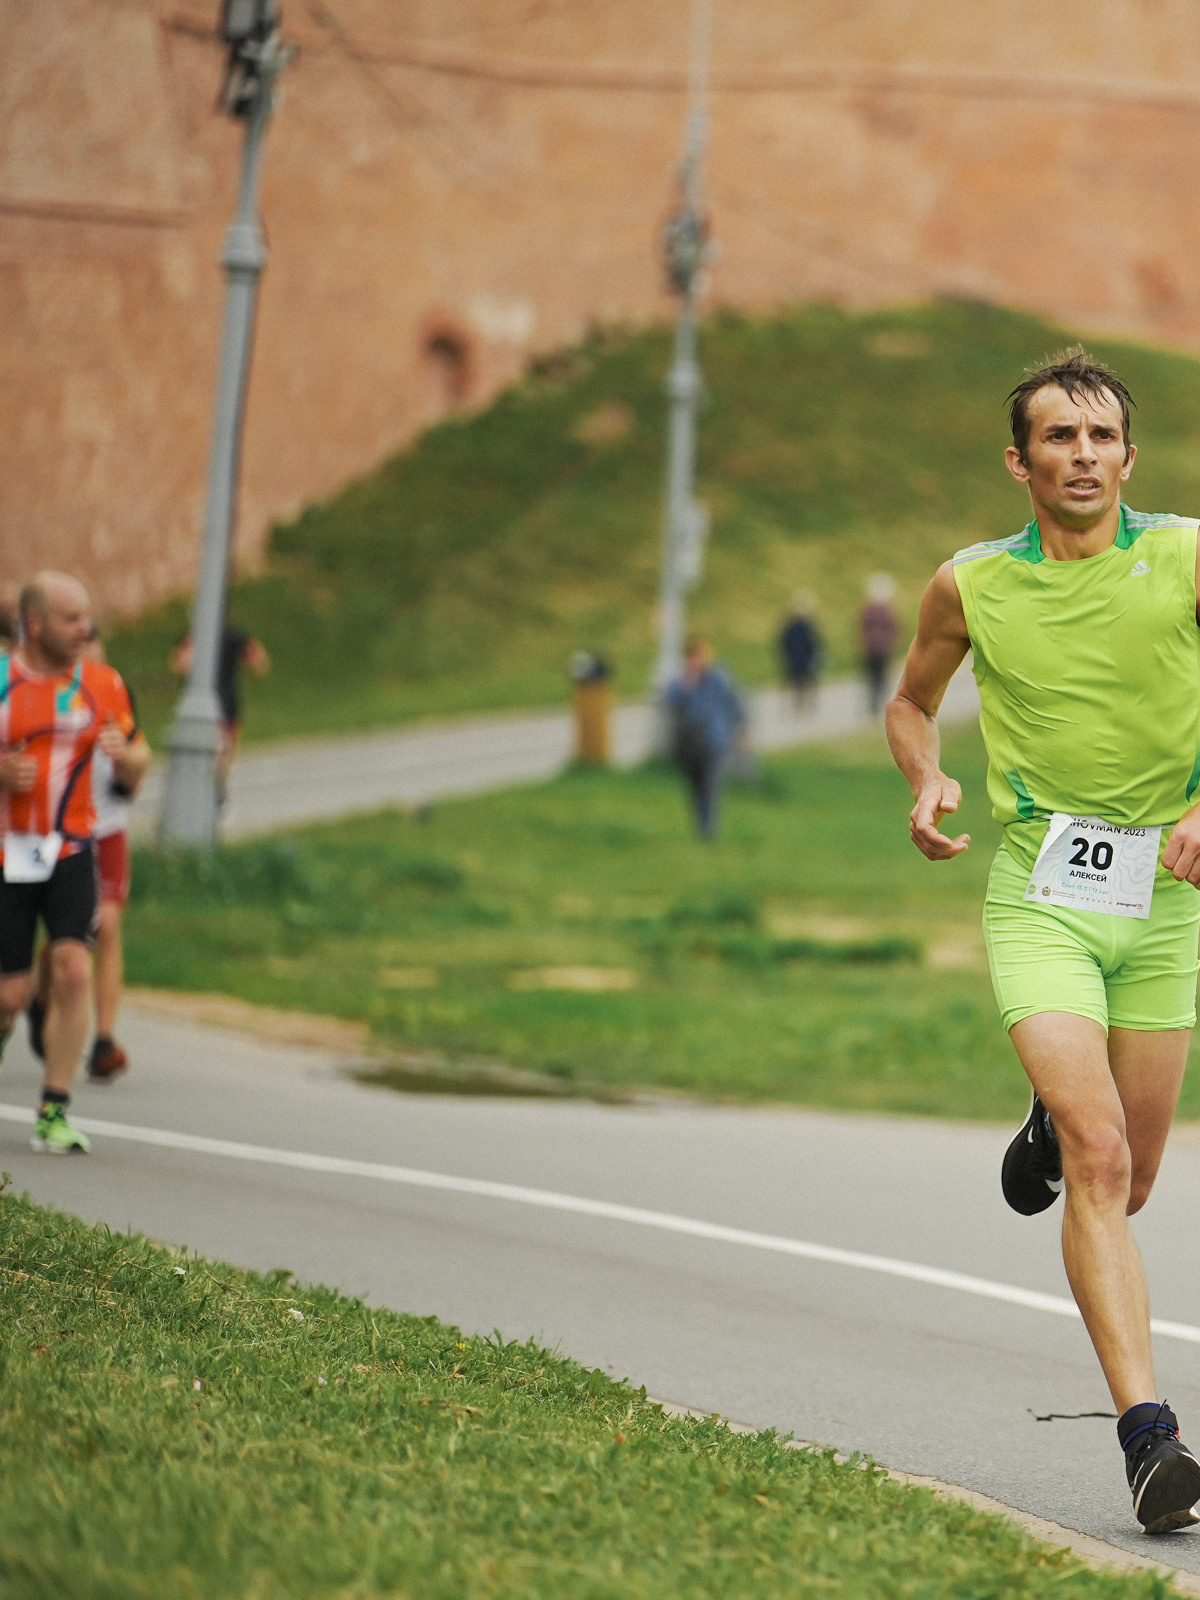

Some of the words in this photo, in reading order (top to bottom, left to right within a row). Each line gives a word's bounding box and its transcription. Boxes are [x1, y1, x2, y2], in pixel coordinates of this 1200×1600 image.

[1123, 827, 1146, 837] 2023
[1068, 837, 1114, 871] 20
[1069, 870, 1108, 883] АЛЕКСЕЙ
